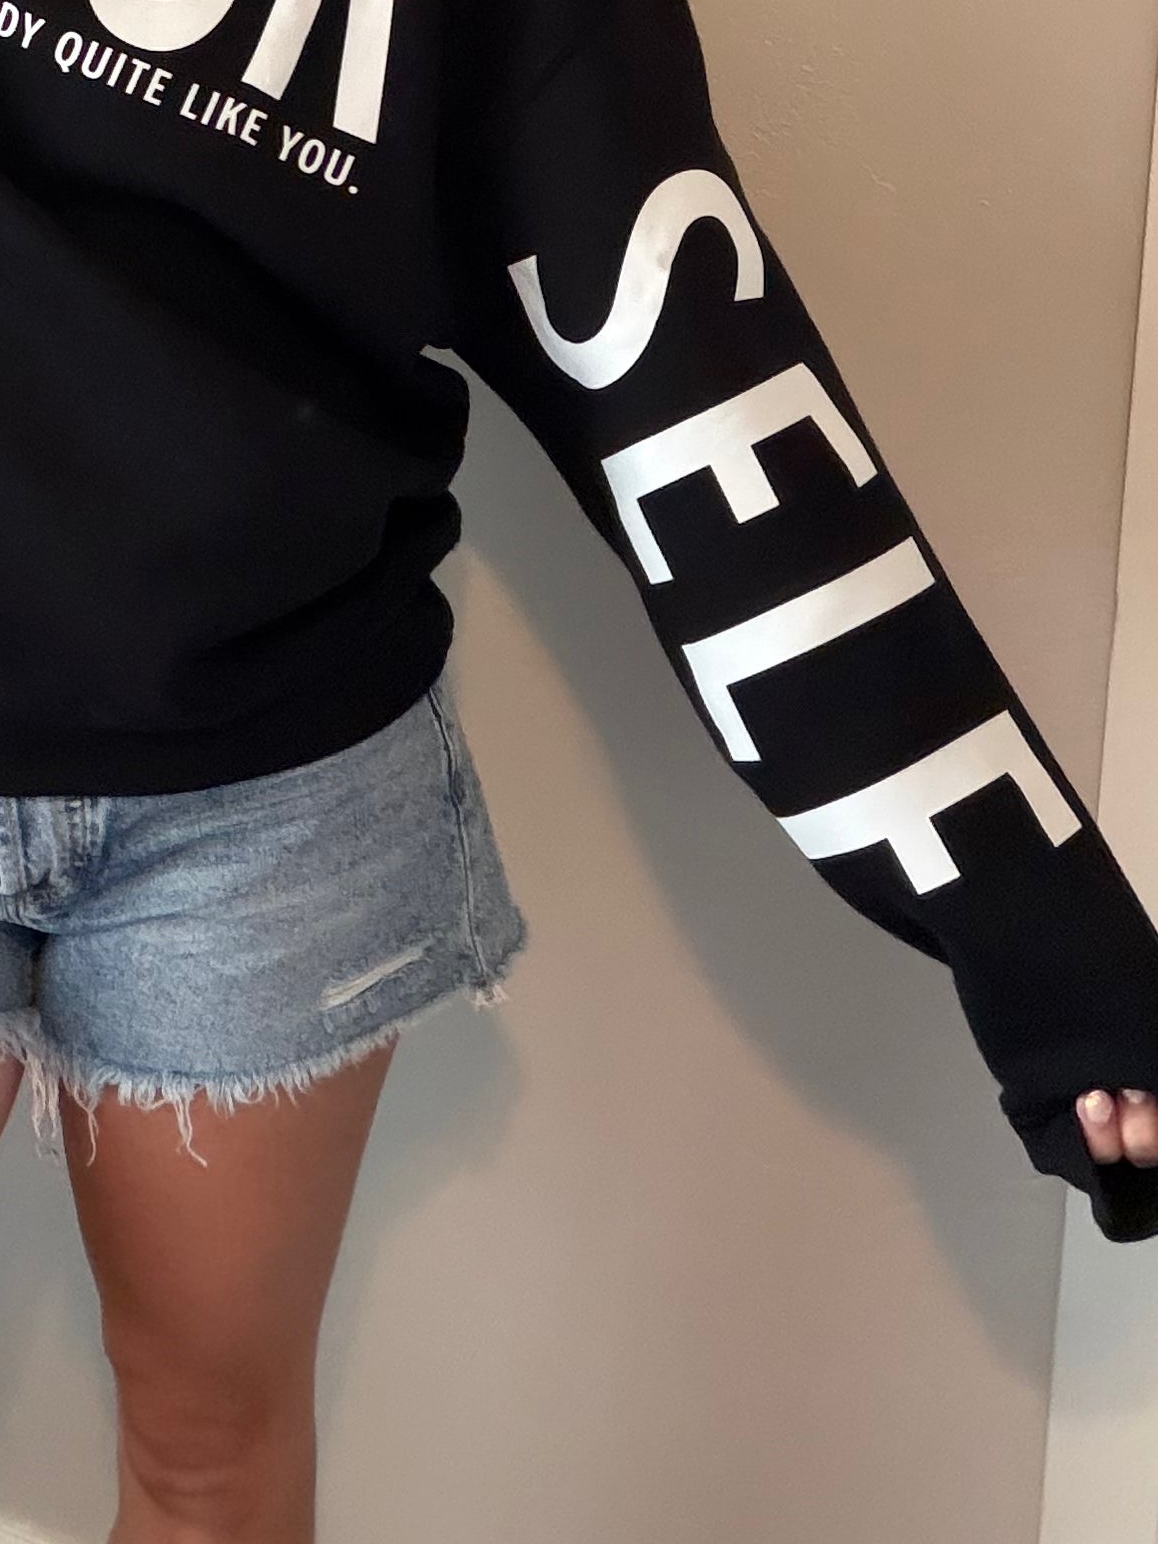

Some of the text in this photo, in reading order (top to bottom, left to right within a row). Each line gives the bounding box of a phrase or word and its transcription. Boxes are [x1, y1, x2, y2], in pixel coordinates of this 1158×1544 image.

[54, 31, 174, 106] QUITE
[179, 83, 268, 146] LIKE
[278, 125, 359, 195] YOU.
[508, 169, 1082, 896] SELF
